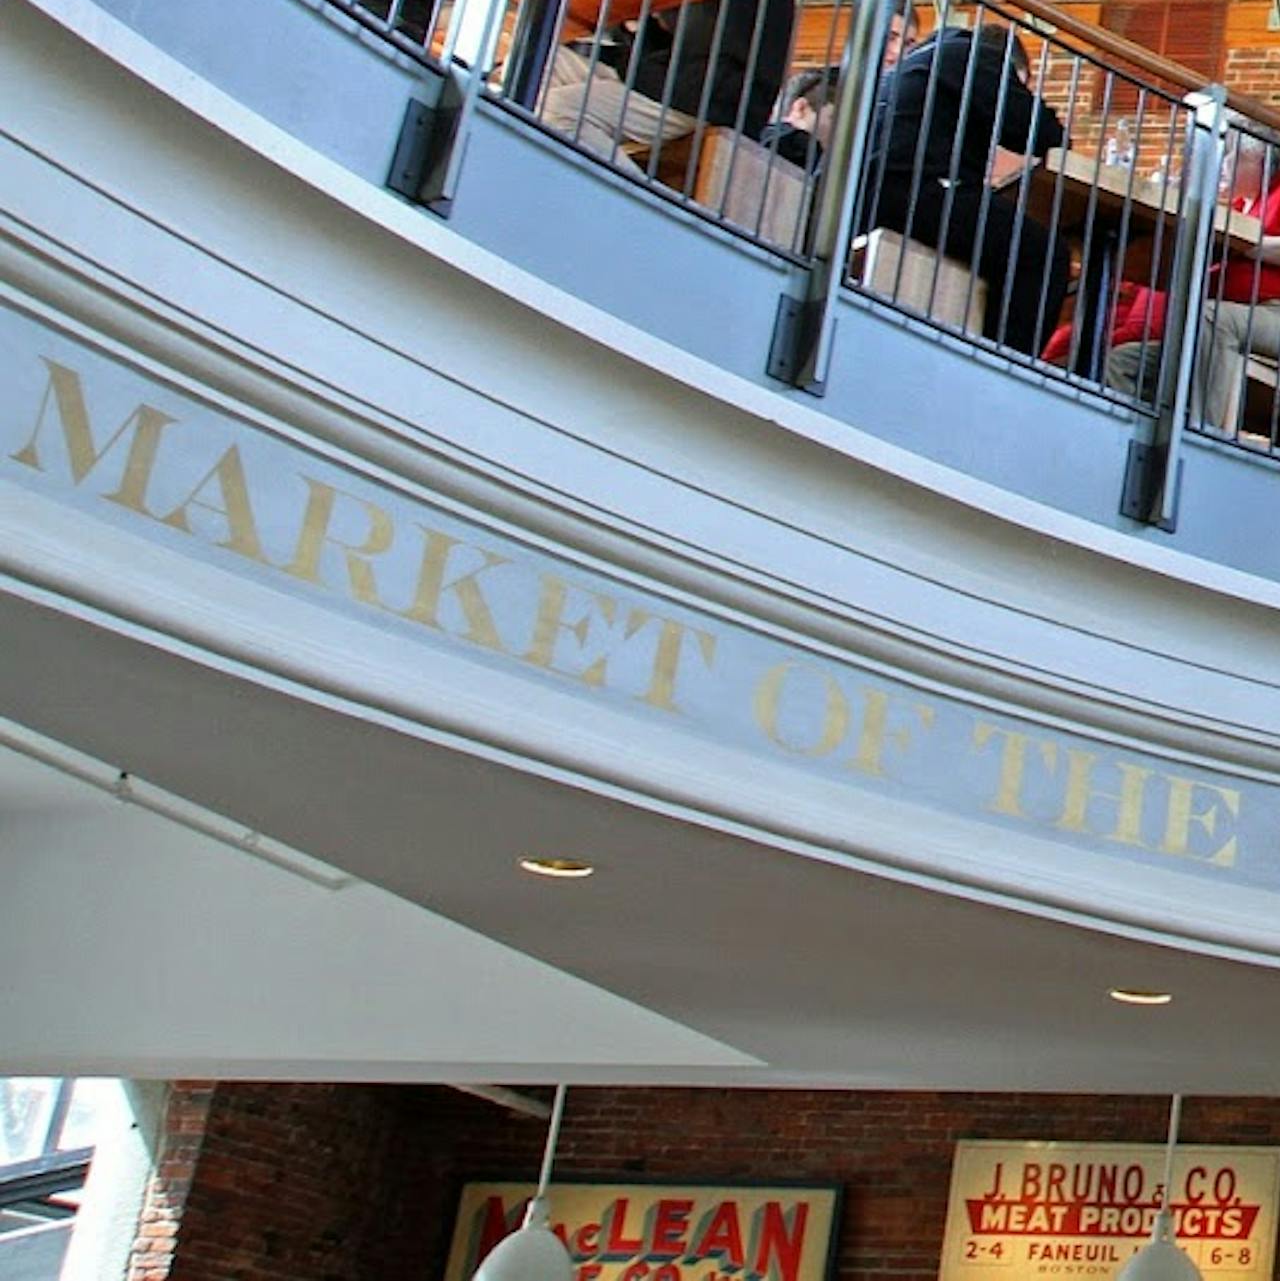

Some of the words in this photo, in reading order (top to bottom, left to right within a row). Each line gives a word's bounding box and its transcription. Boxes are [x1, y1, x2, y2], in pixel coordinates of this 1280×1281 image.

[10, 354, 717, 715] MARKET
[752, 660, 935, 779] OF
[972, 723, 1241, 868] THE
[983, 1163, 1006, 1200] J.
[1021, 1163, 1144, 1204] BRUNO
[981, 1205, 1069, 1233] MEAT
[965, 1241, 1005, 1260] 2-4
[1027, 1243, 1120, 1263] FANEUIL
[1210, 1247, 1252, 1266] 6-8
